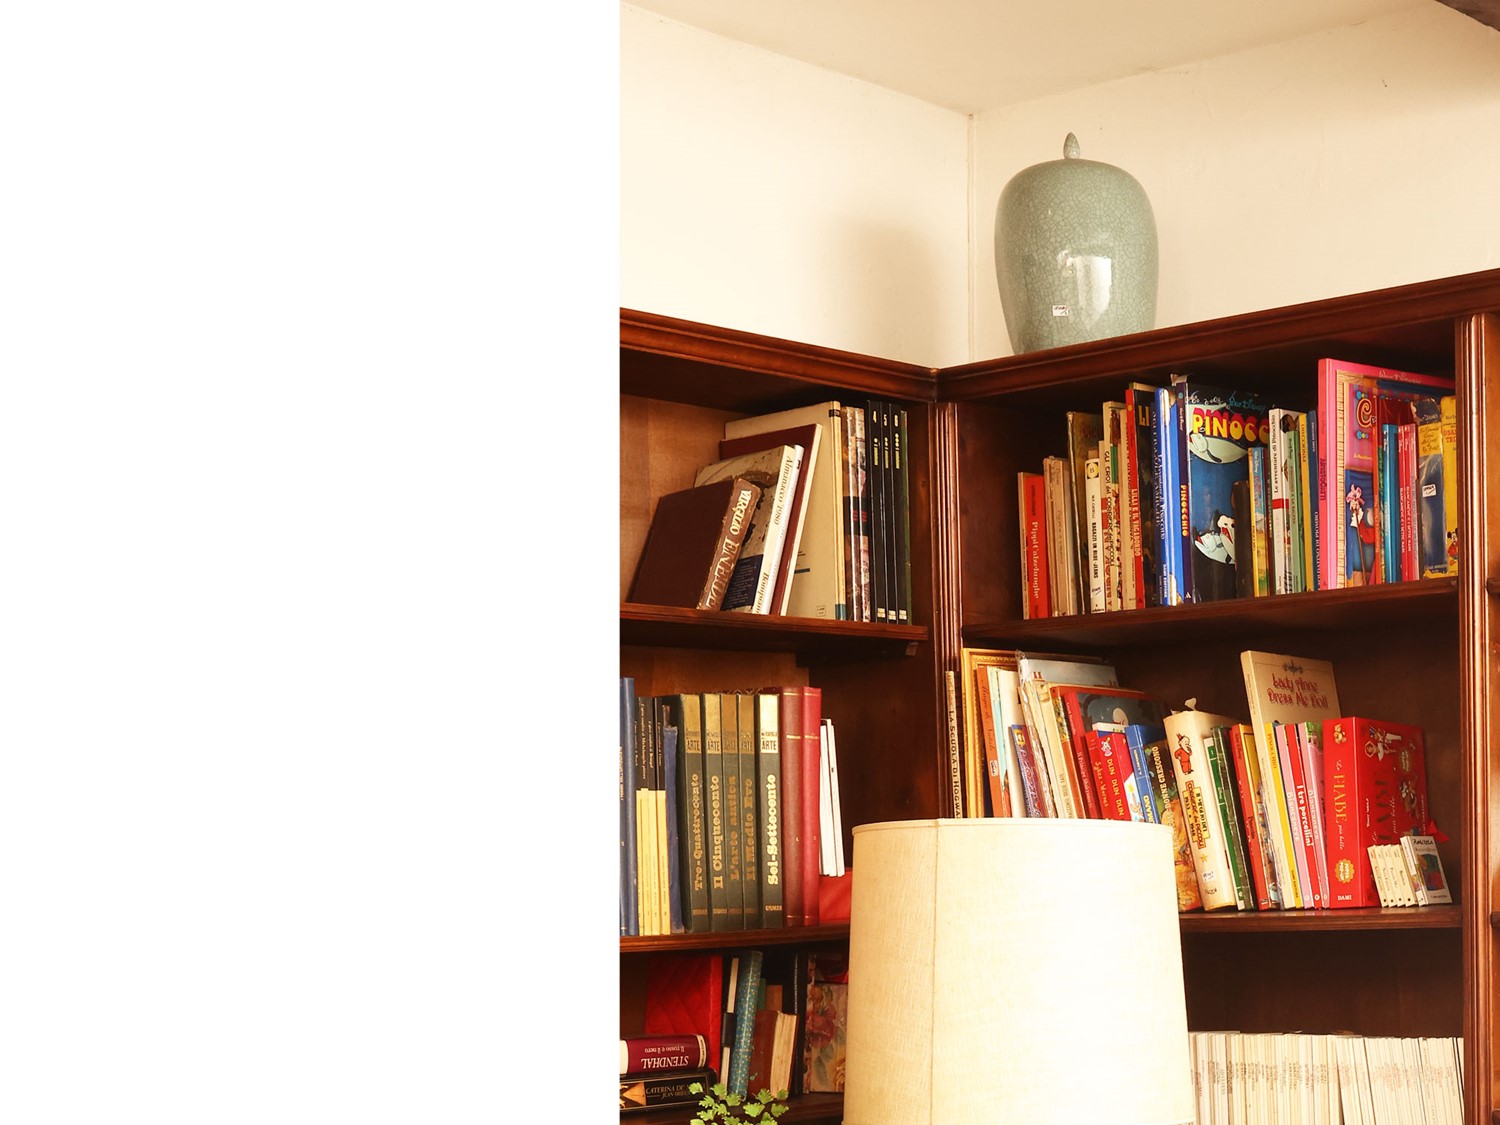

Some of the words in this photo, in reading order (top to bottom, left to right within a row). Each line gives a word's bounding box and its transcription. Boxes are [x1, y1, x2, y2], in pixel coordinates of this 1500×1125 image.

[1102, 450, 1110, 462] GLI
[1103, 466, 1111, 483] EROI
[777, 456, 793, 503] Almanacco
[730, 489, 752, 536] VIRGILIO
[773, 503, 784, 526] 1980
[1180, 484, 1190, 537] PINOCCHIO
[1133, 520, 1141, 557] VAGABONDO
[706, 536, 740, 610] ENEIDE
[1032, 544, 1040, 599] Calzelunghe
[1267, 688, 1293, 705] Dress
[1296, 691, 1308, 707] Me
[1310, 693, 1329, 709] Doll
[1271, 673, 1294, 692] Lady
[948, 710, 955, 722] LA
[761, 739, 777, 751] ARTE
[949, 725, 957, 761] SCUOLA
[951, 763, 958, 777] DI
[1151, 746, 1165, 783] CRESCONO
[1106, 758, 1115, 775] DLIN
[1111, 779, 1120, 795] DLIN
[1116, 800, 1125, 816] DLIN
[1158, 783, 1169, 807] DONNE
[1333, 774, 1348, 822] FIABE
[692, 773, 704, 891] Tre-Quattrocento
[711, 775, 723, 872] Cinquecento
[766, 773, 779, 886] Sei-Settecento
[1287, 791, 1300, 842] Biancaneve
[1300, 805, 1314, 847] porcellini
[1308, 790, 1320, 841] Biancaneve
[713, 875, 723, 889] Il
[641, 1055, 689, 1069] STENDHAL
[646, 1085, 676, 1095] CATERINA
